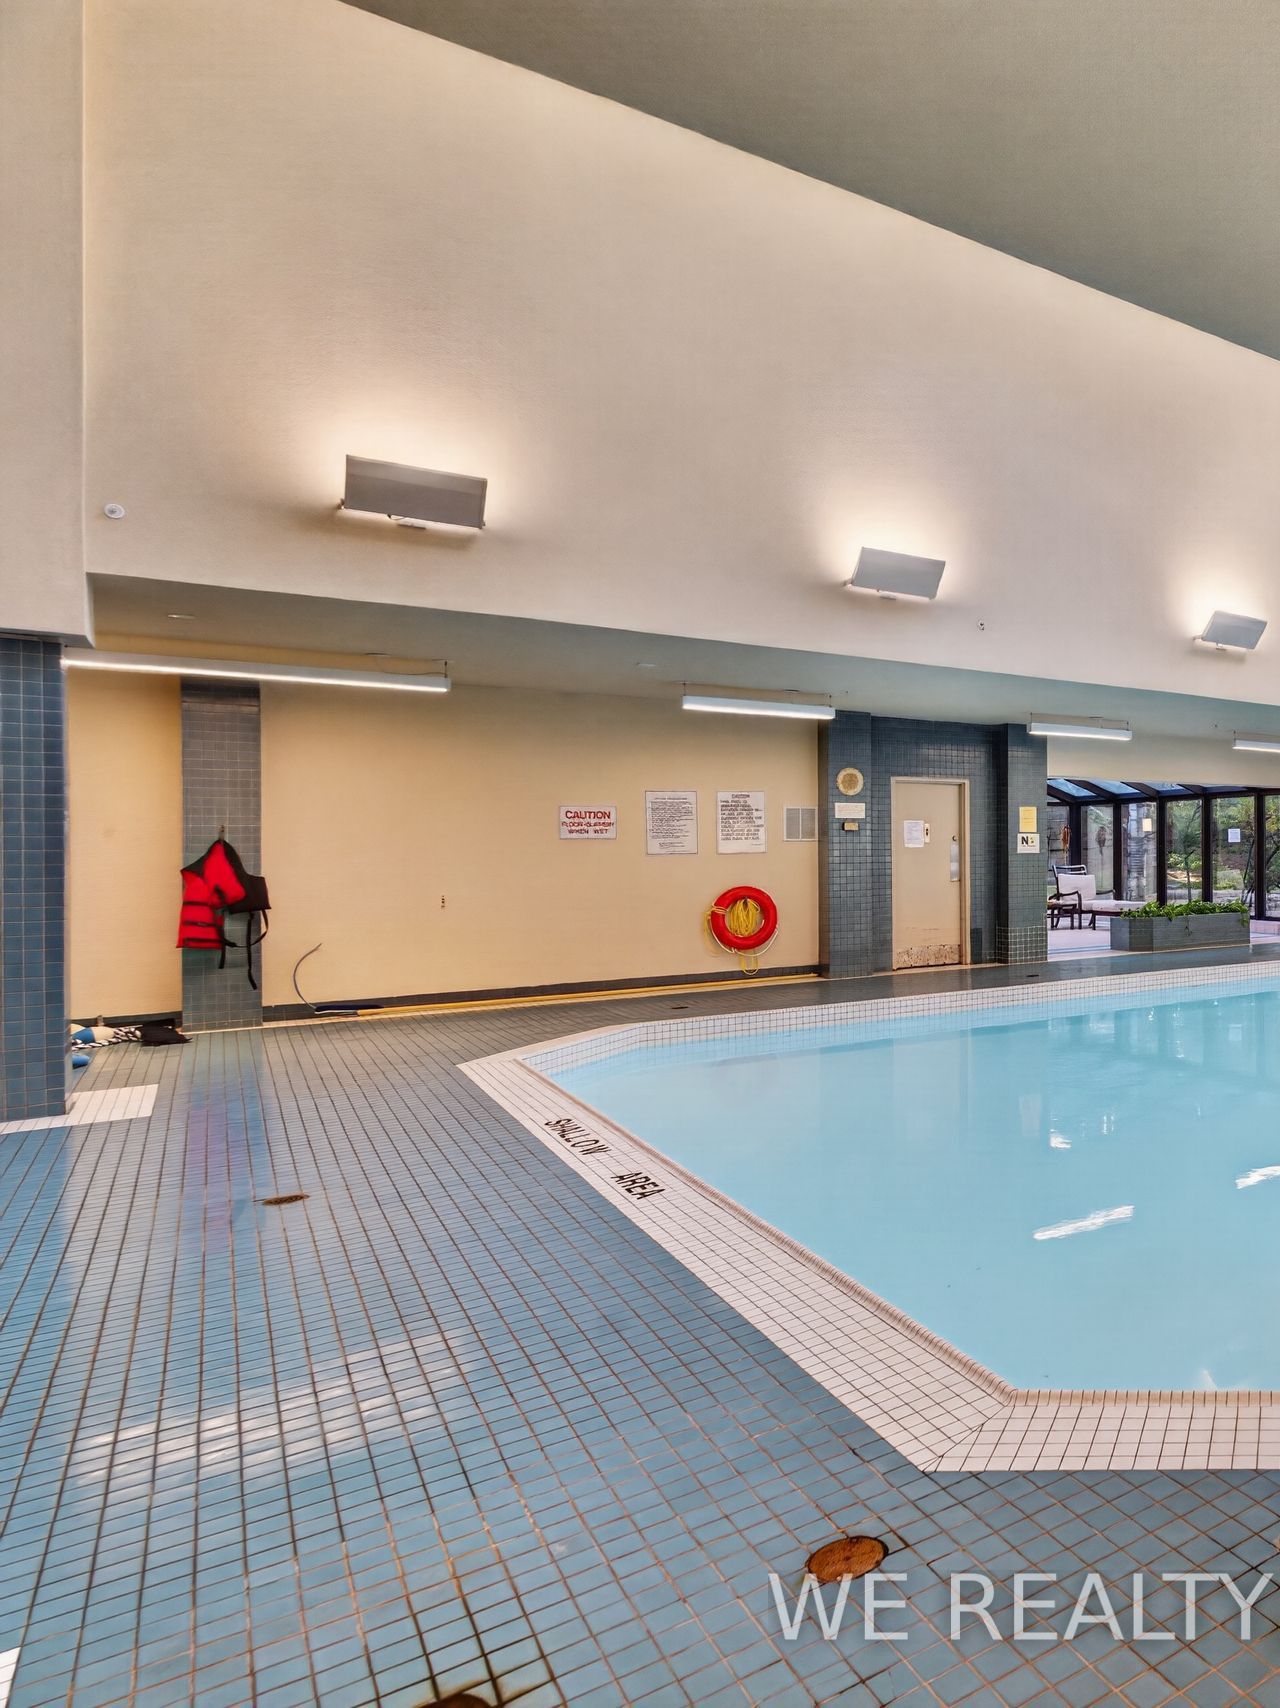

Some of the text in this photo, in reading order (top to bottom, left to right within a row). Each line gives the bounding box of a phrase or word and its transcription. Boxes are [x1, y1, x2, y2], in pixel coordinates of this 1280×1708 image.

[565, 810, 611, 819] CAUTION
[544, 1118, 666, 1200] SHALLOW AREA
